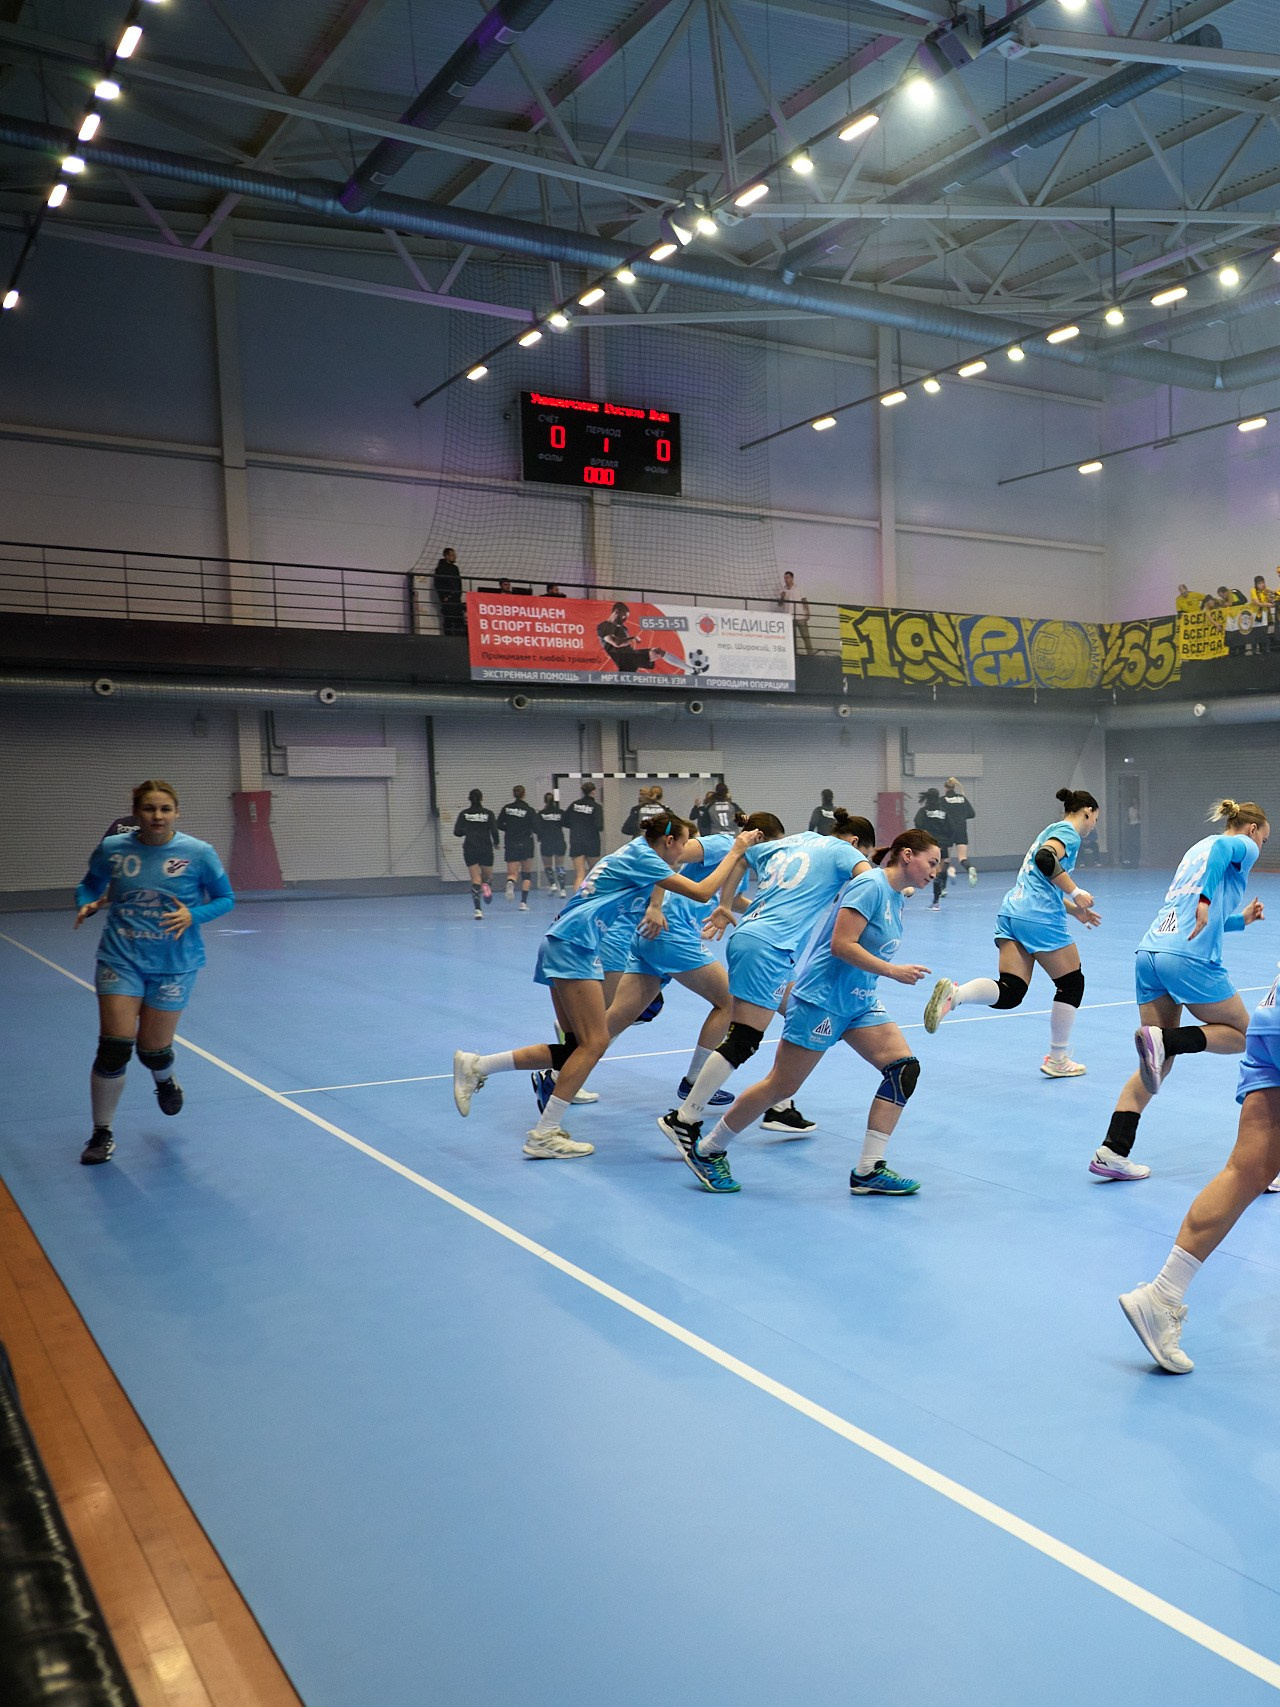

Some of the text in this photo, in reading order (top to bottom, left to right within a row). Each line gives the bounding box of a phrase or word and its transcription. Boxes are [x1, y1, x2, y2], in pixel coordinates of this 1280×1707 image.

[550, 425, 566, 449] 0
[585, 425, 622, 438] ПЕРИОД
[603, 437, 610, 453] 1
[656, 439, 671, 462] 0
[537, 453, 563, 463] ФОЛЫ
[590, 457, 619, 468] ВРЕМЯ
[644, 465, 669, 475] ФОЛЫ
[478, 603, 566, 619] ВОЗВРАЩАЕМ
[479, 619, 585, 635] В СПОРТ БЫСТРО
[641, 617, 686, 629] 65-51-51
[721, 617, 786, 634] МЕДИЦЕЯ
[1183, 625, 1223, 640] ВСЕГДА
[480, 634, 584, 649] И ЭФФЕКТИВНО!
[1182, 640, 1223, 654] ВСЕГДА
[481, 651, 531, 662] Принимаем
[539, 654, 566, 663] любой
[482, 669, 580, 681] ЭКСТРЕННАЯ ПОМОЩЬ
[706, 678, 790, 690] ПРОВОДИМ ОПЕРАЦИИ
[717, 812, 729, 827] 11
